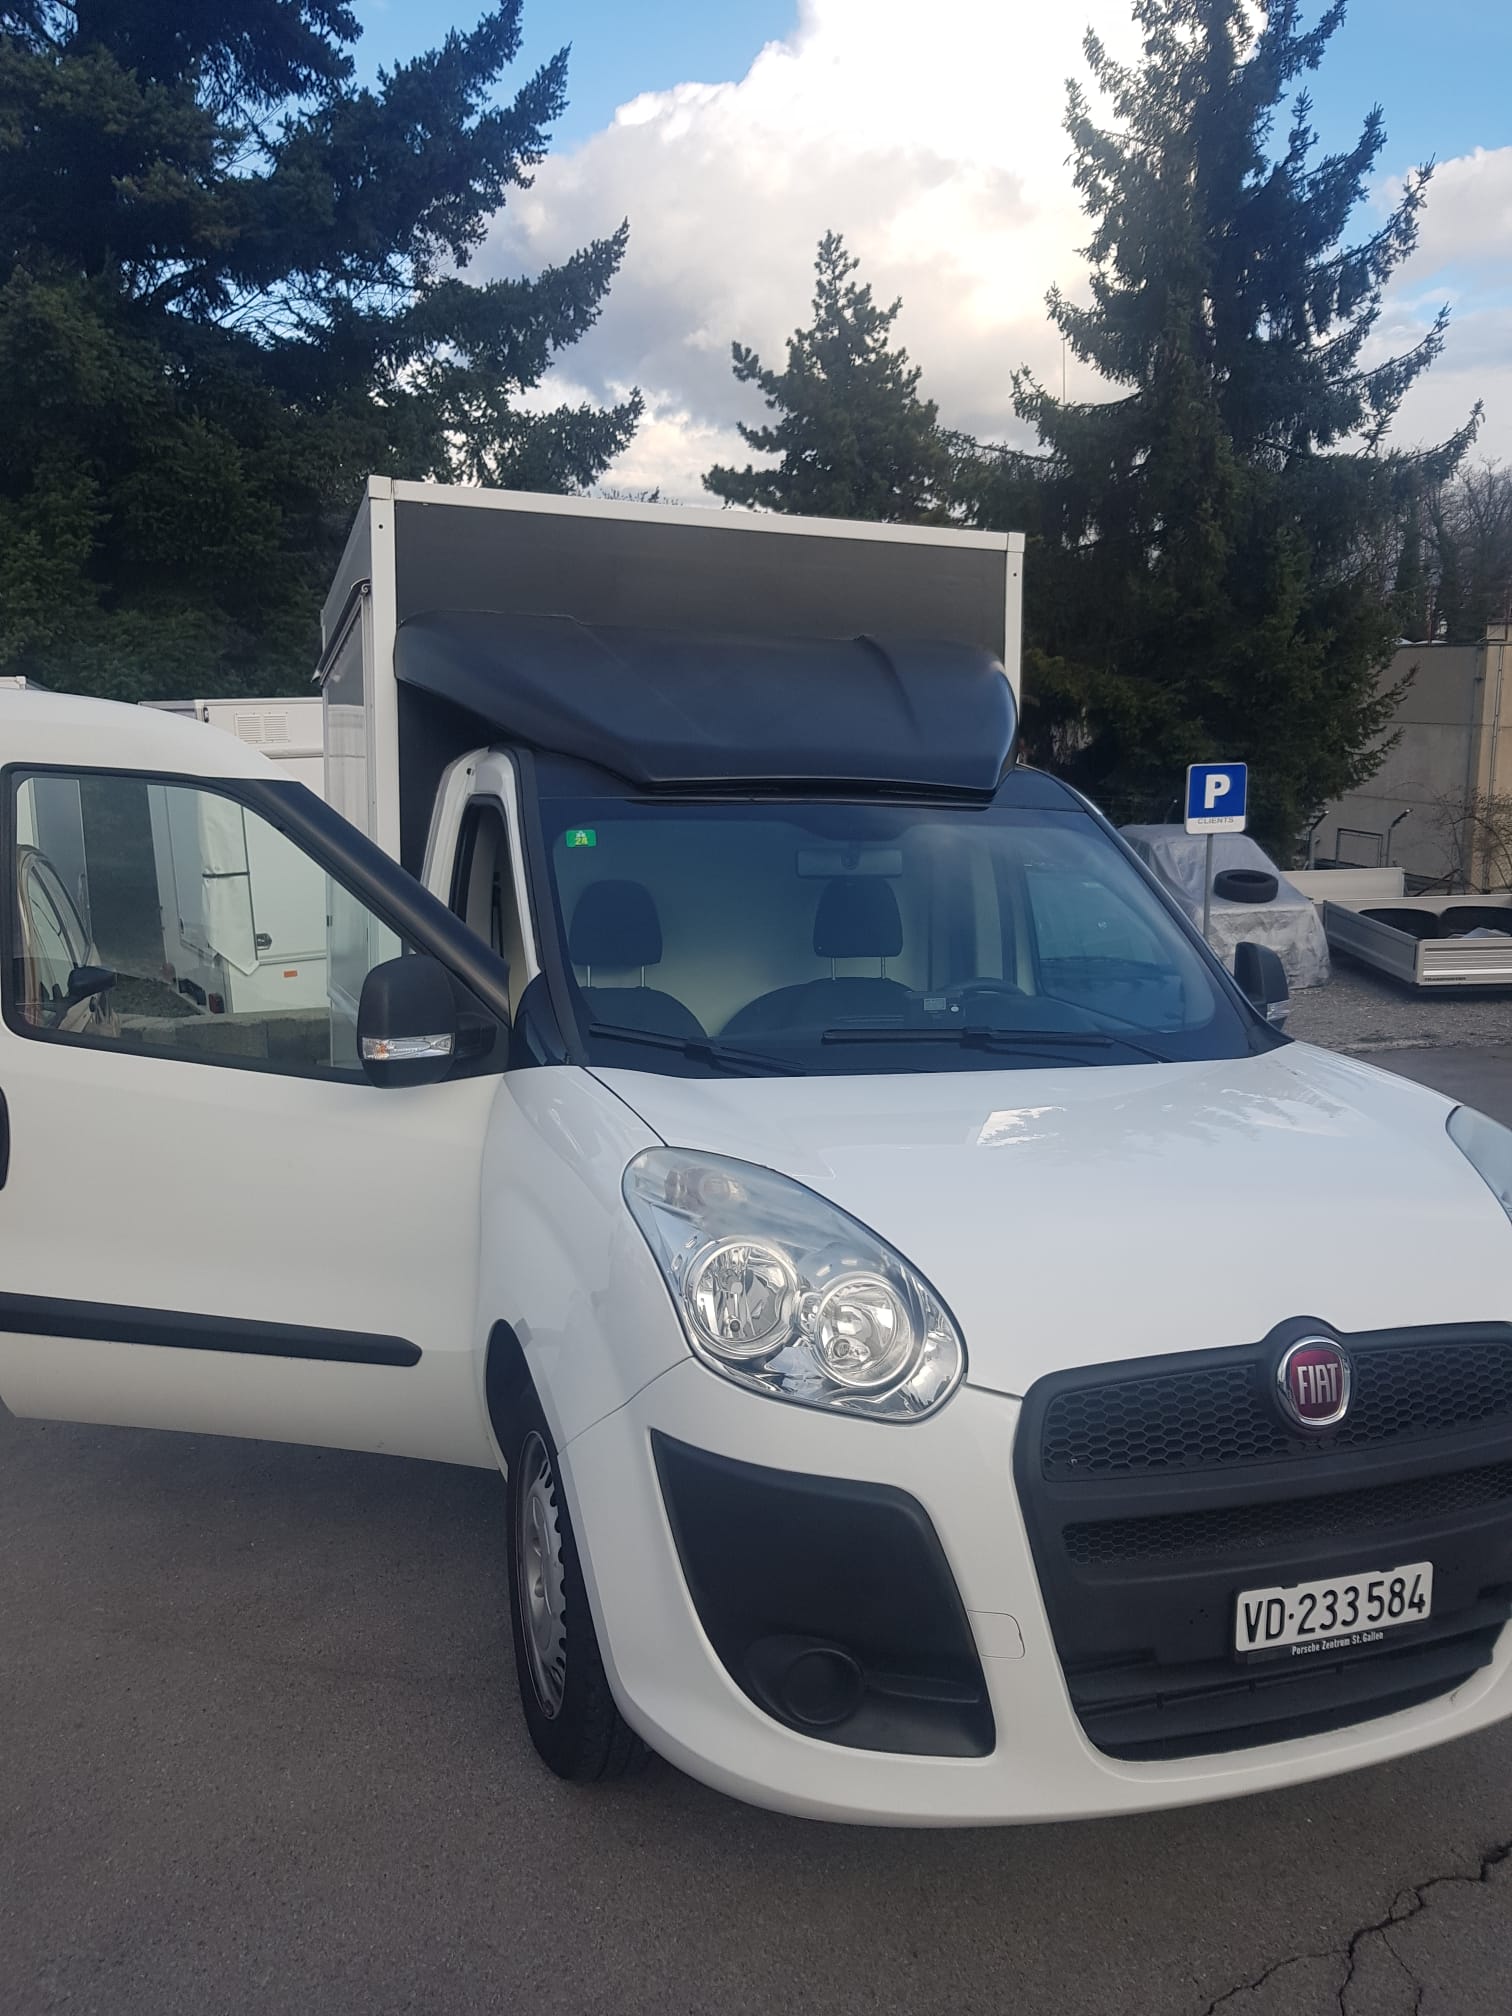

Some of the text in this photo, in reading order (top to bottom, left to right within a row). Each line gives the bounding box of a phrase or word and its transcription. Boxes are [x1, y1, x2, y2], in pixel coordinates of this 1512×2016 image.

[1204, 774, 1230, 808] P
[1197, 816, 1234, 824] CLIENTS
[1297, 1363, 1338, 1405] FIAT
[1291, 1631, 1384, 1656] Porsche Zentrum St. Gallen
